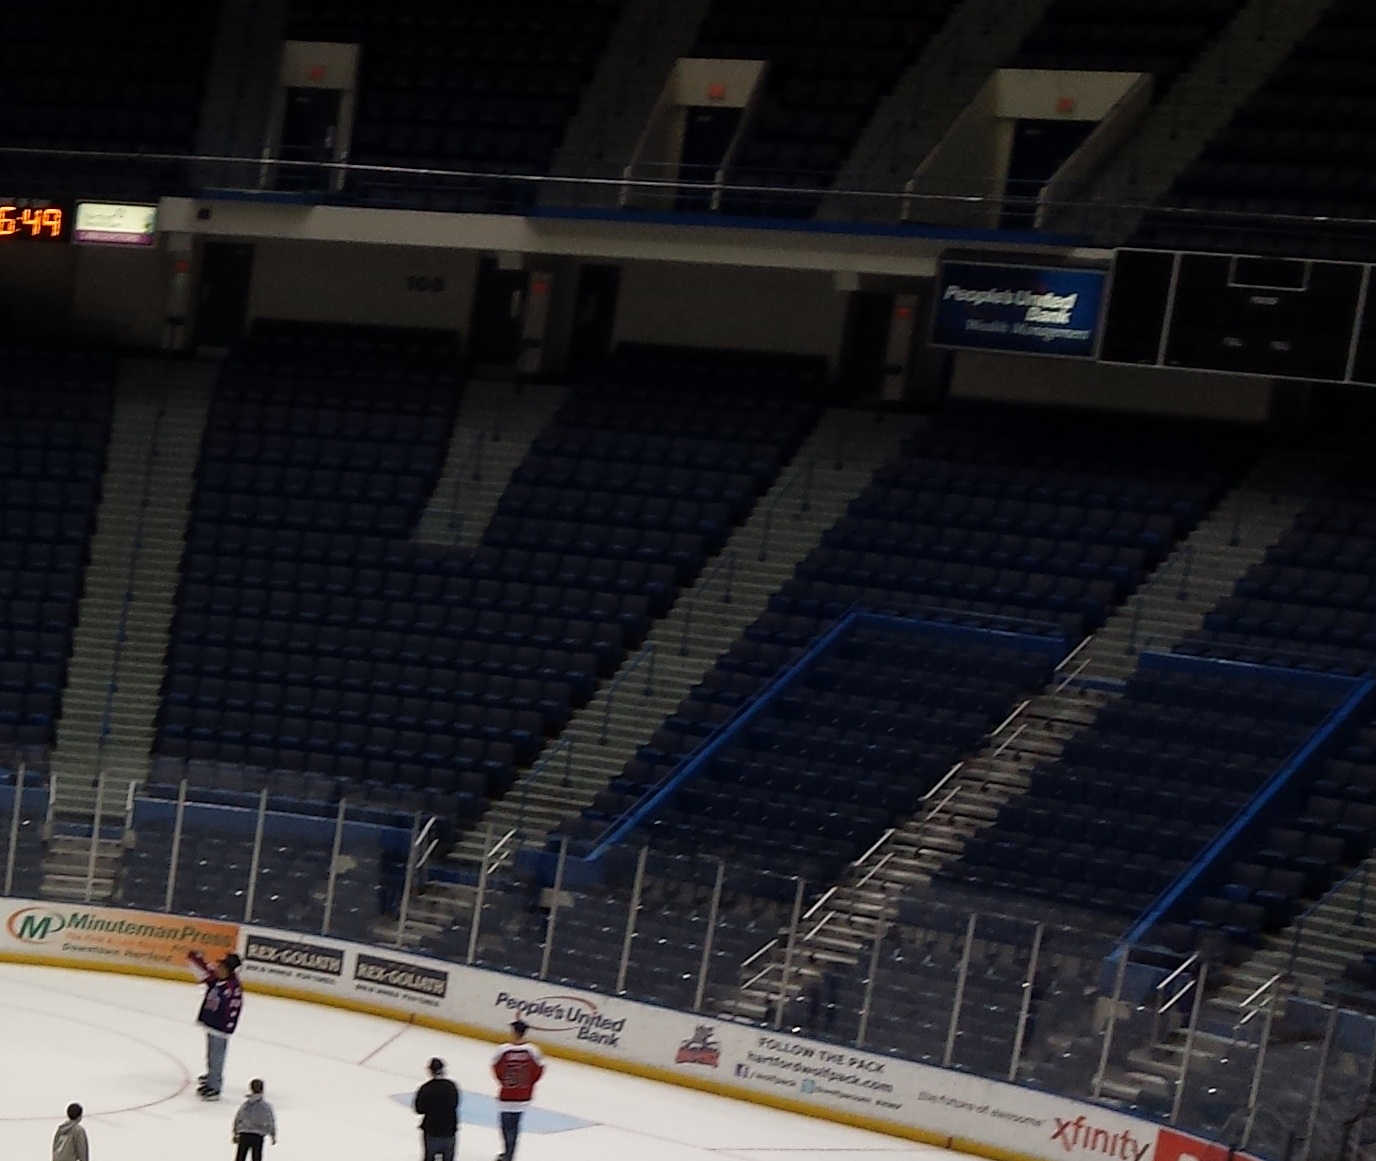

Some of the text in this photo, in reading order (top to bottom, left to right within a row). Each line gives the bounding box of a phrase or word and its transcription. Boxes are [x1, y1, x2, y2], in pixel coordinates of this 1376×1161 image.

[495, 991, 627, 1033] People's United
[576, 1026, 620, 1048] Bank
[758, 1036, 887, 1074] FOLLOW THE PACK
